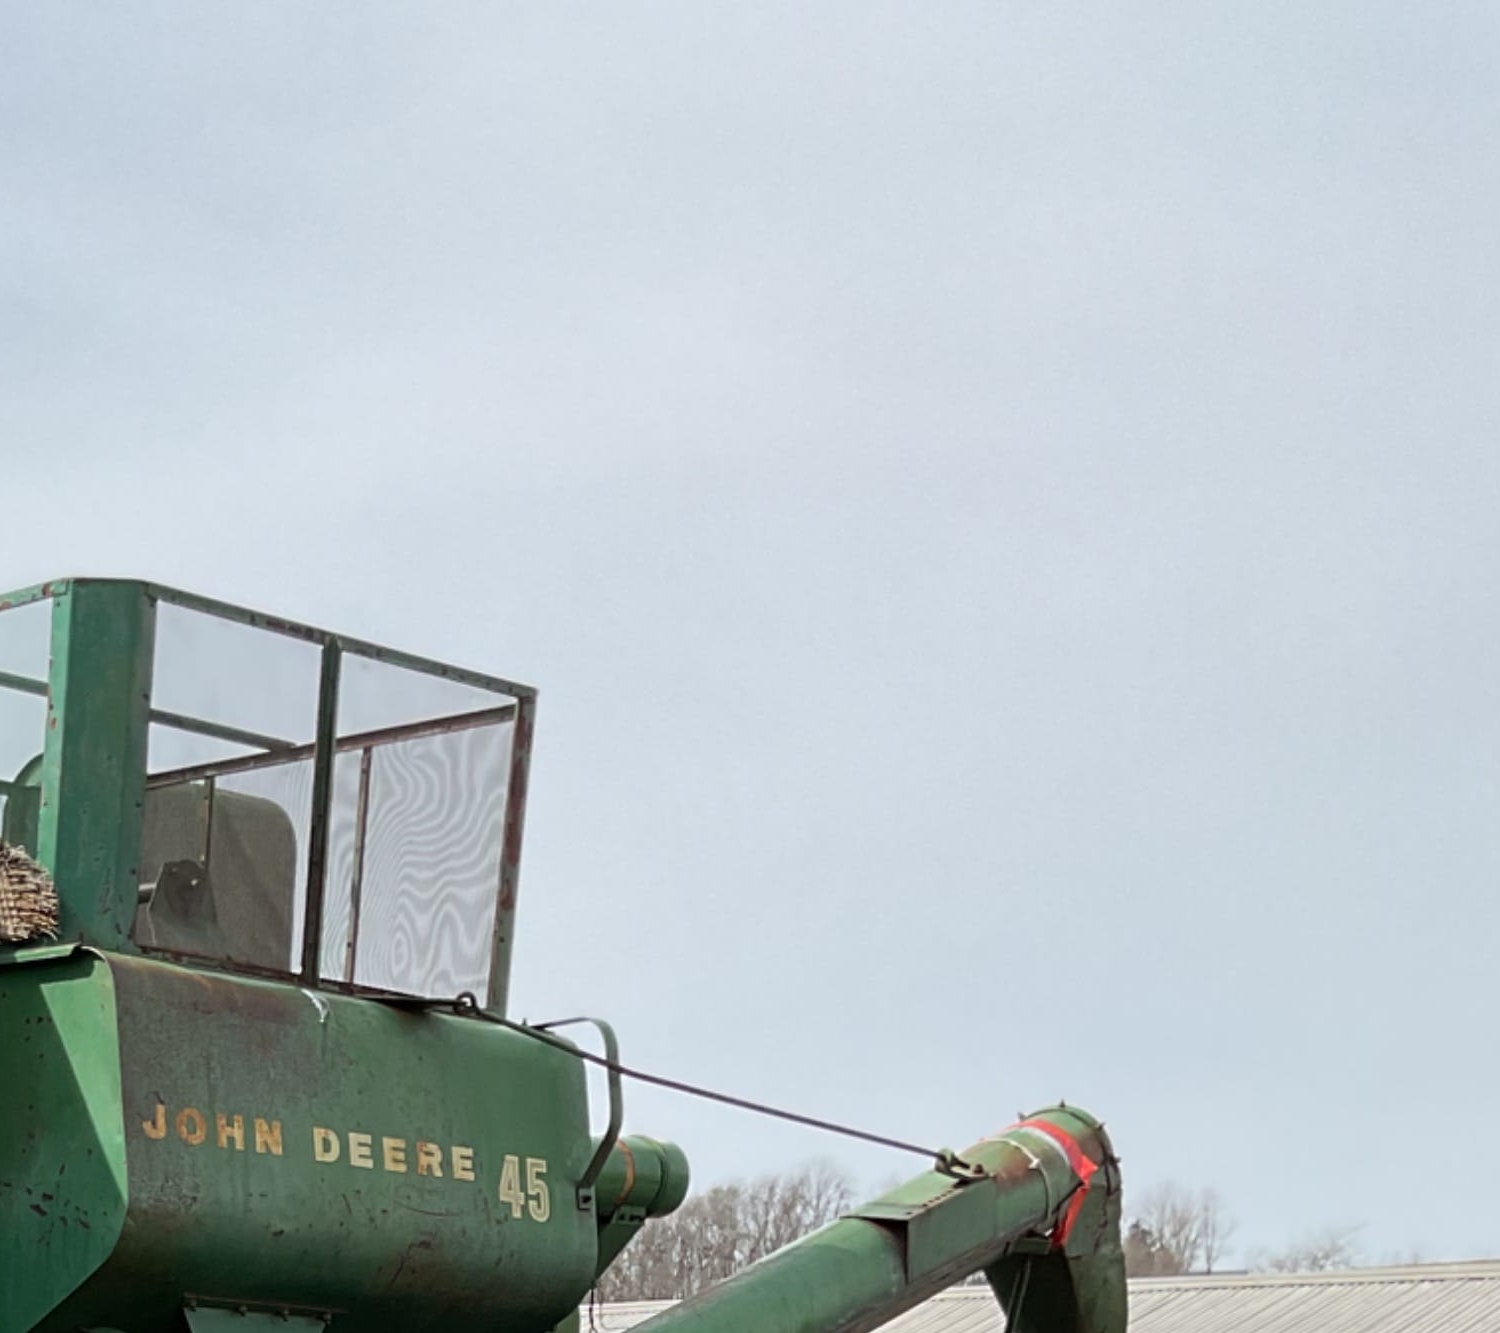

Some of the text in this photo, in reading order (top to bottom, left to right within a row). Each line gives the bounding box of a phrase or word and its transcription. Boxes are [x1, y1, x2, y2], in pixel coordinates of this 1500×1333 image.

[142, 1104, 476, 1182] JOHN DEERE
[499, 1153, 550, 1223] 45
